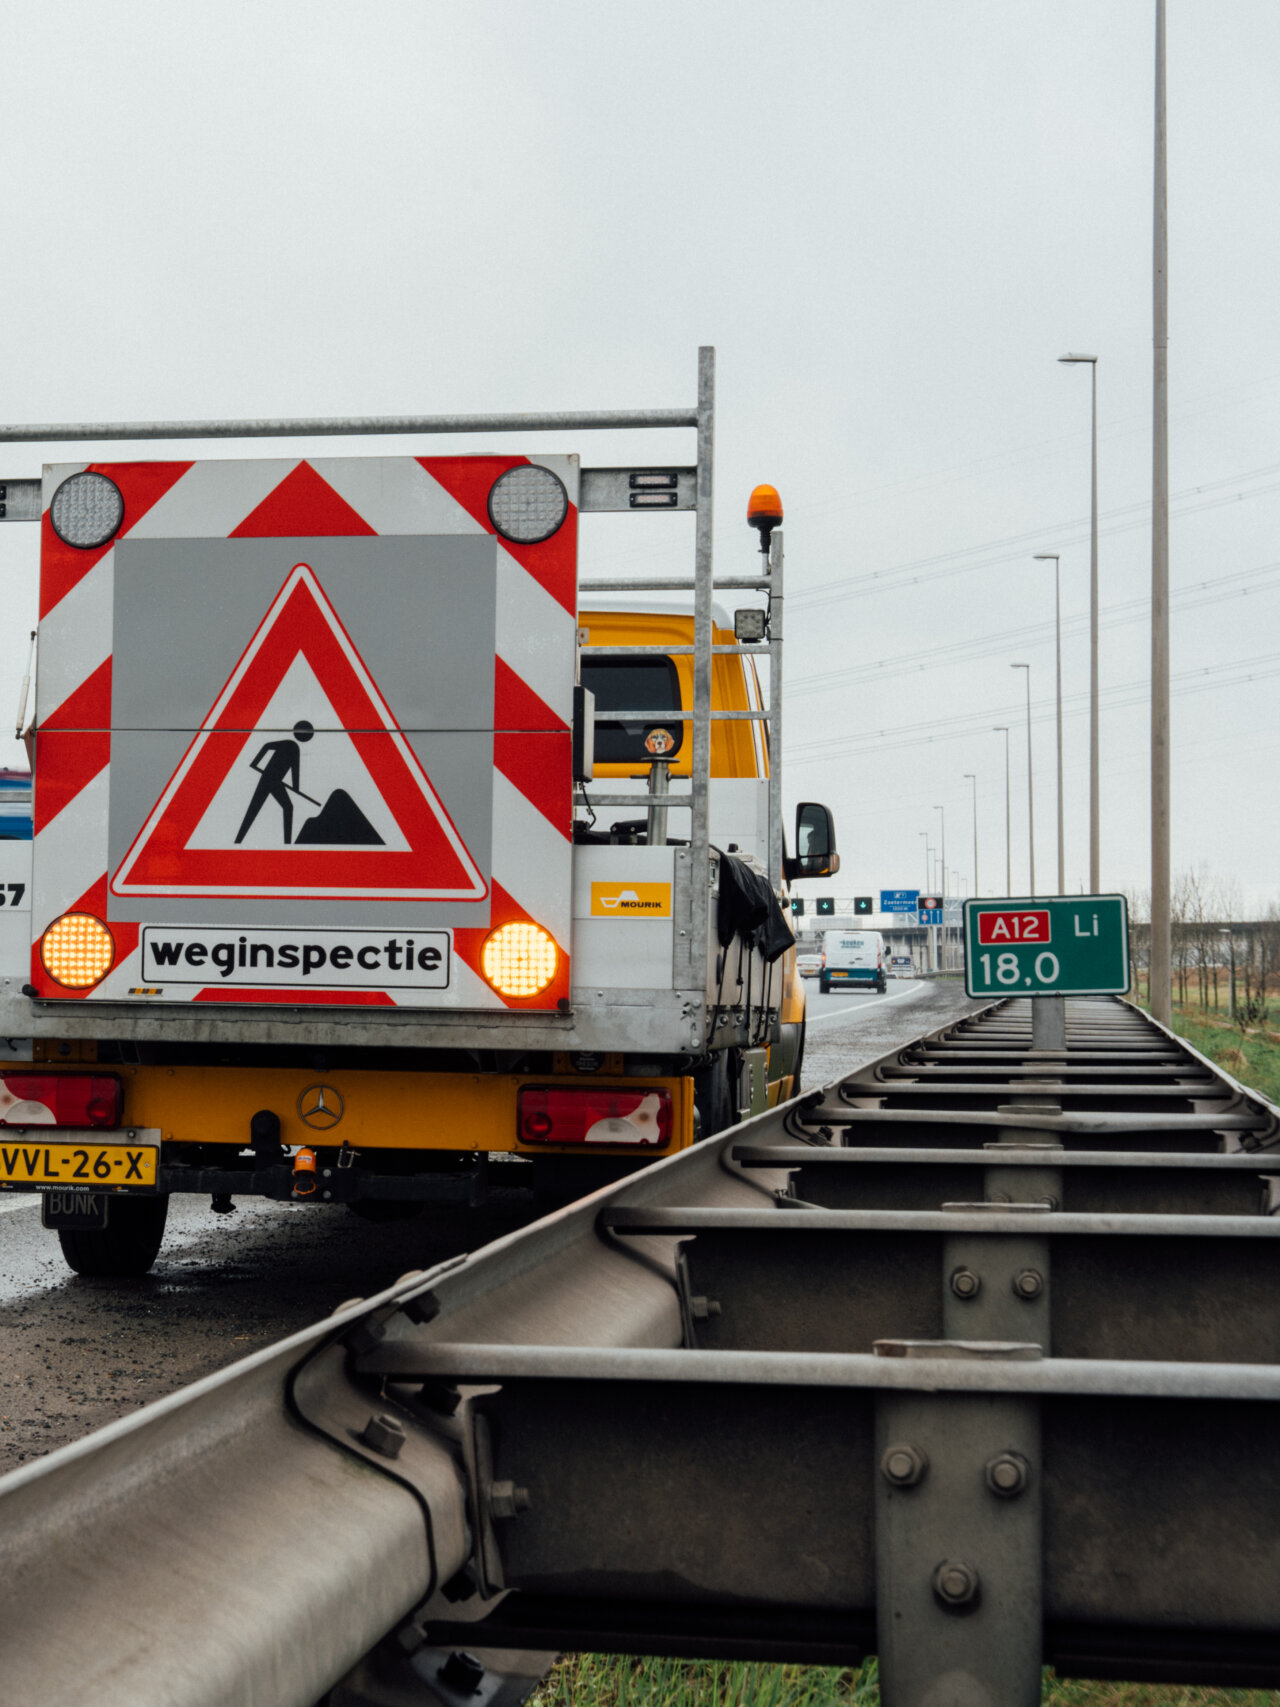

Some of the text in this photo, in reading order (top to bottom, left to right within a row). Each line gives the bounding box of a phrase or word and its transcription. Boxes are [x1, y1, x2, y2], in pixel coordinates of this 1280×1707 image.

[991, 914, 1099, 939] A12 Li
[150, 936, 442, 978] weginspectie
[980, 952, 1060, 987] 18,0
[1, 1148, 144, 1180] VVL-26-X
[35, 1184, 90, 1192] www.mourik.com
[49, 1193, 99, 1216] BUNK
